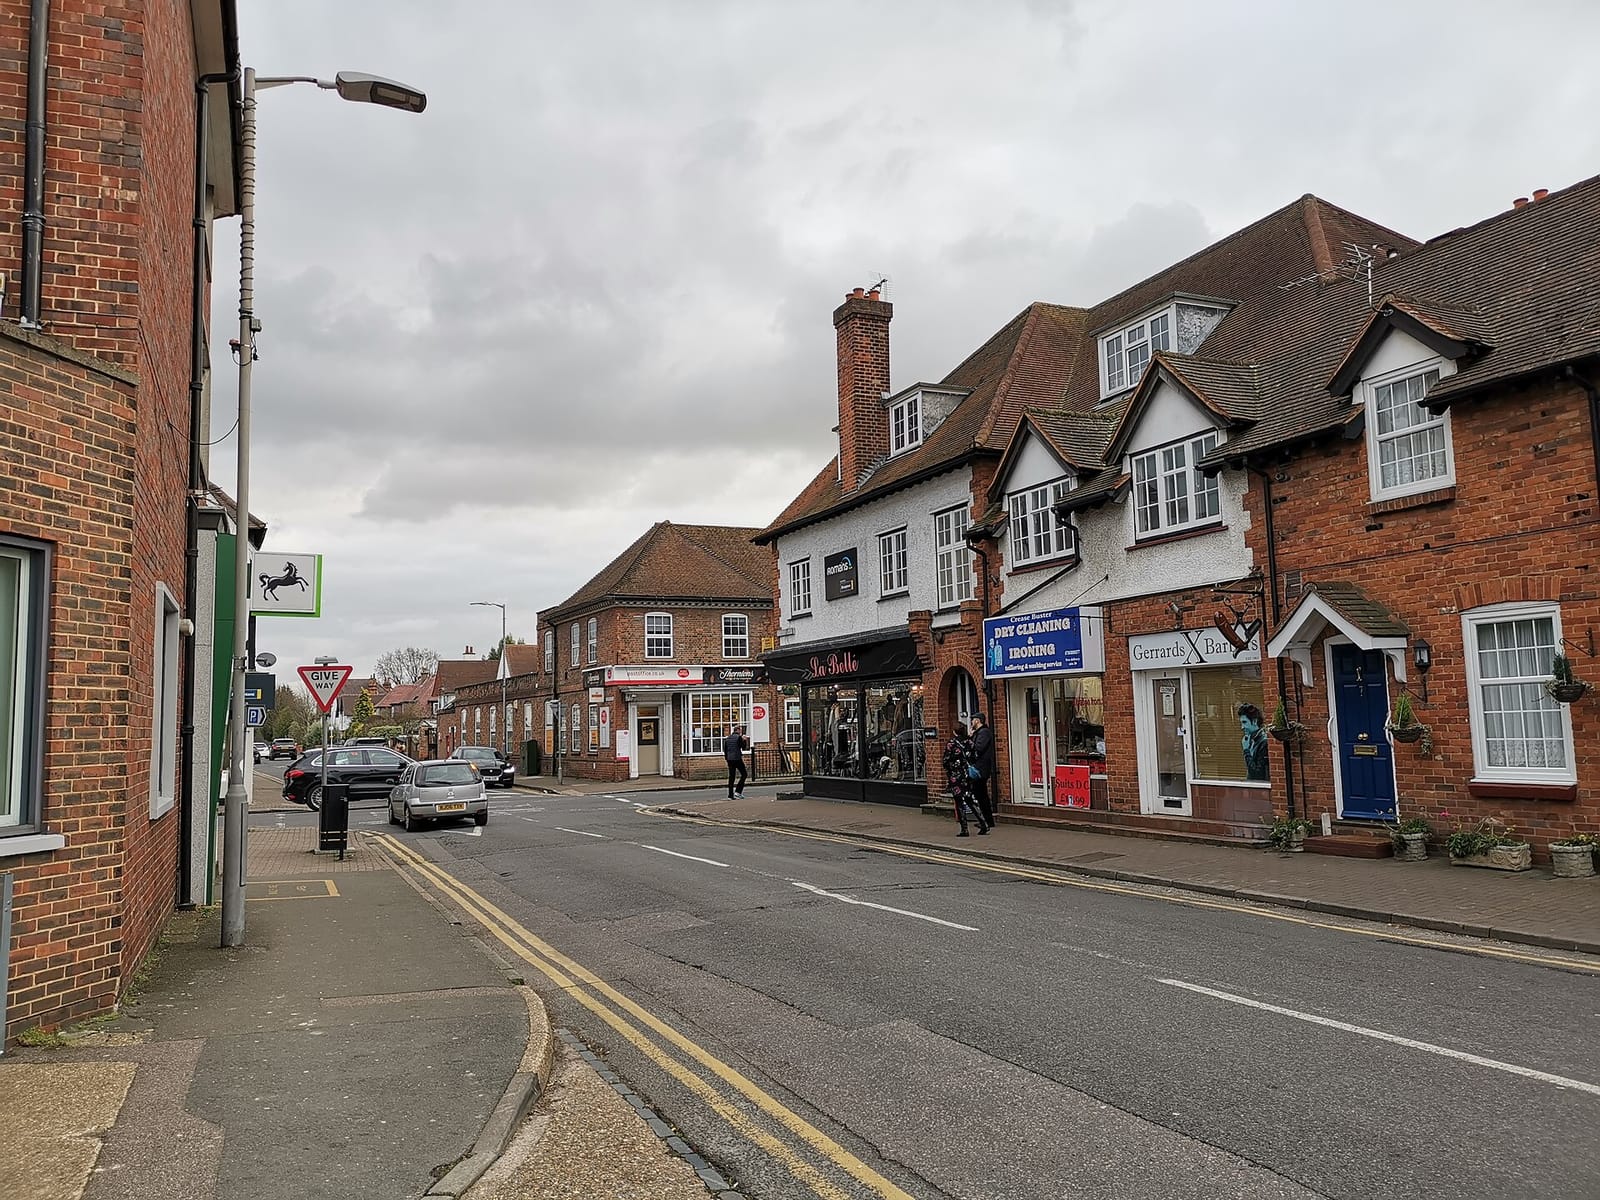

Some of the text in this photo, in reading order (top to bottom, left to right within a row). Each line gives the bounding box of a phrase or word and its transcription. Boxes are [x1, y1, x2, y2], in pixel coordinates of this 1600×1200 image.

[994, 618, 1070, 639] DRY CLEANING
[1027, 636, 1034, 644] &
[1009, 644, 1056, 659] IRONING
[1133, 641, 1186, 660] Gerrards
[810, 656, 827, 678] La
[311, 672, 338, 680] GIVE
[719, 669, 754, 679] Thorntons
[250, 710, 256, 720] P
[1056, 778, 1089, 790] Suits D C
